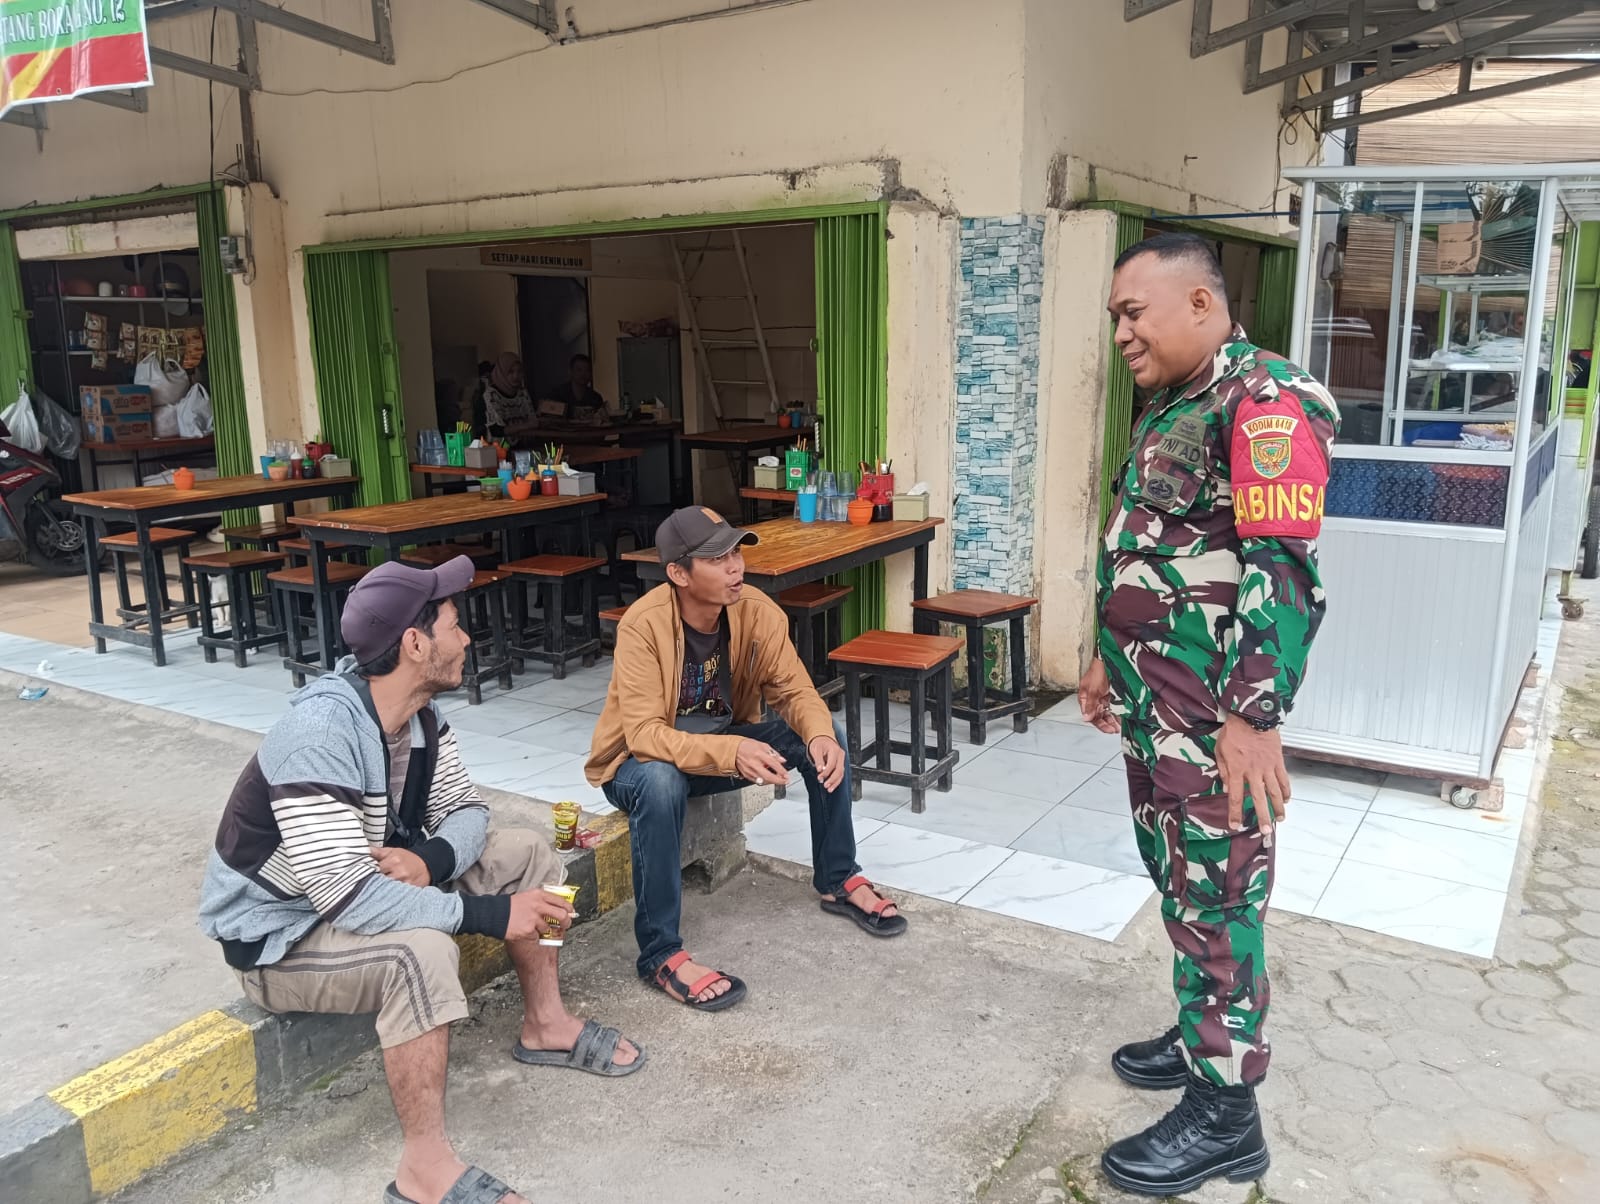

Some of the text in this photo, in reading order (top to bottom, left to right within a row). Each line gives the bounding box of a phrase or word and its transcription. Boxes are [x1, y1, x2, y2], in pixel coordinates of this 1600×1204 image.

[0, 12, 36, 43] TANG
[491, 252, 519, 264] SETIAP
[521, 255, 538, 265] HARI
[1246, 418, 1273, 435] KODIM
[1160, 439, 1201, 463] TNI AD
[1231, 483, 1324, 526] ABINSA
